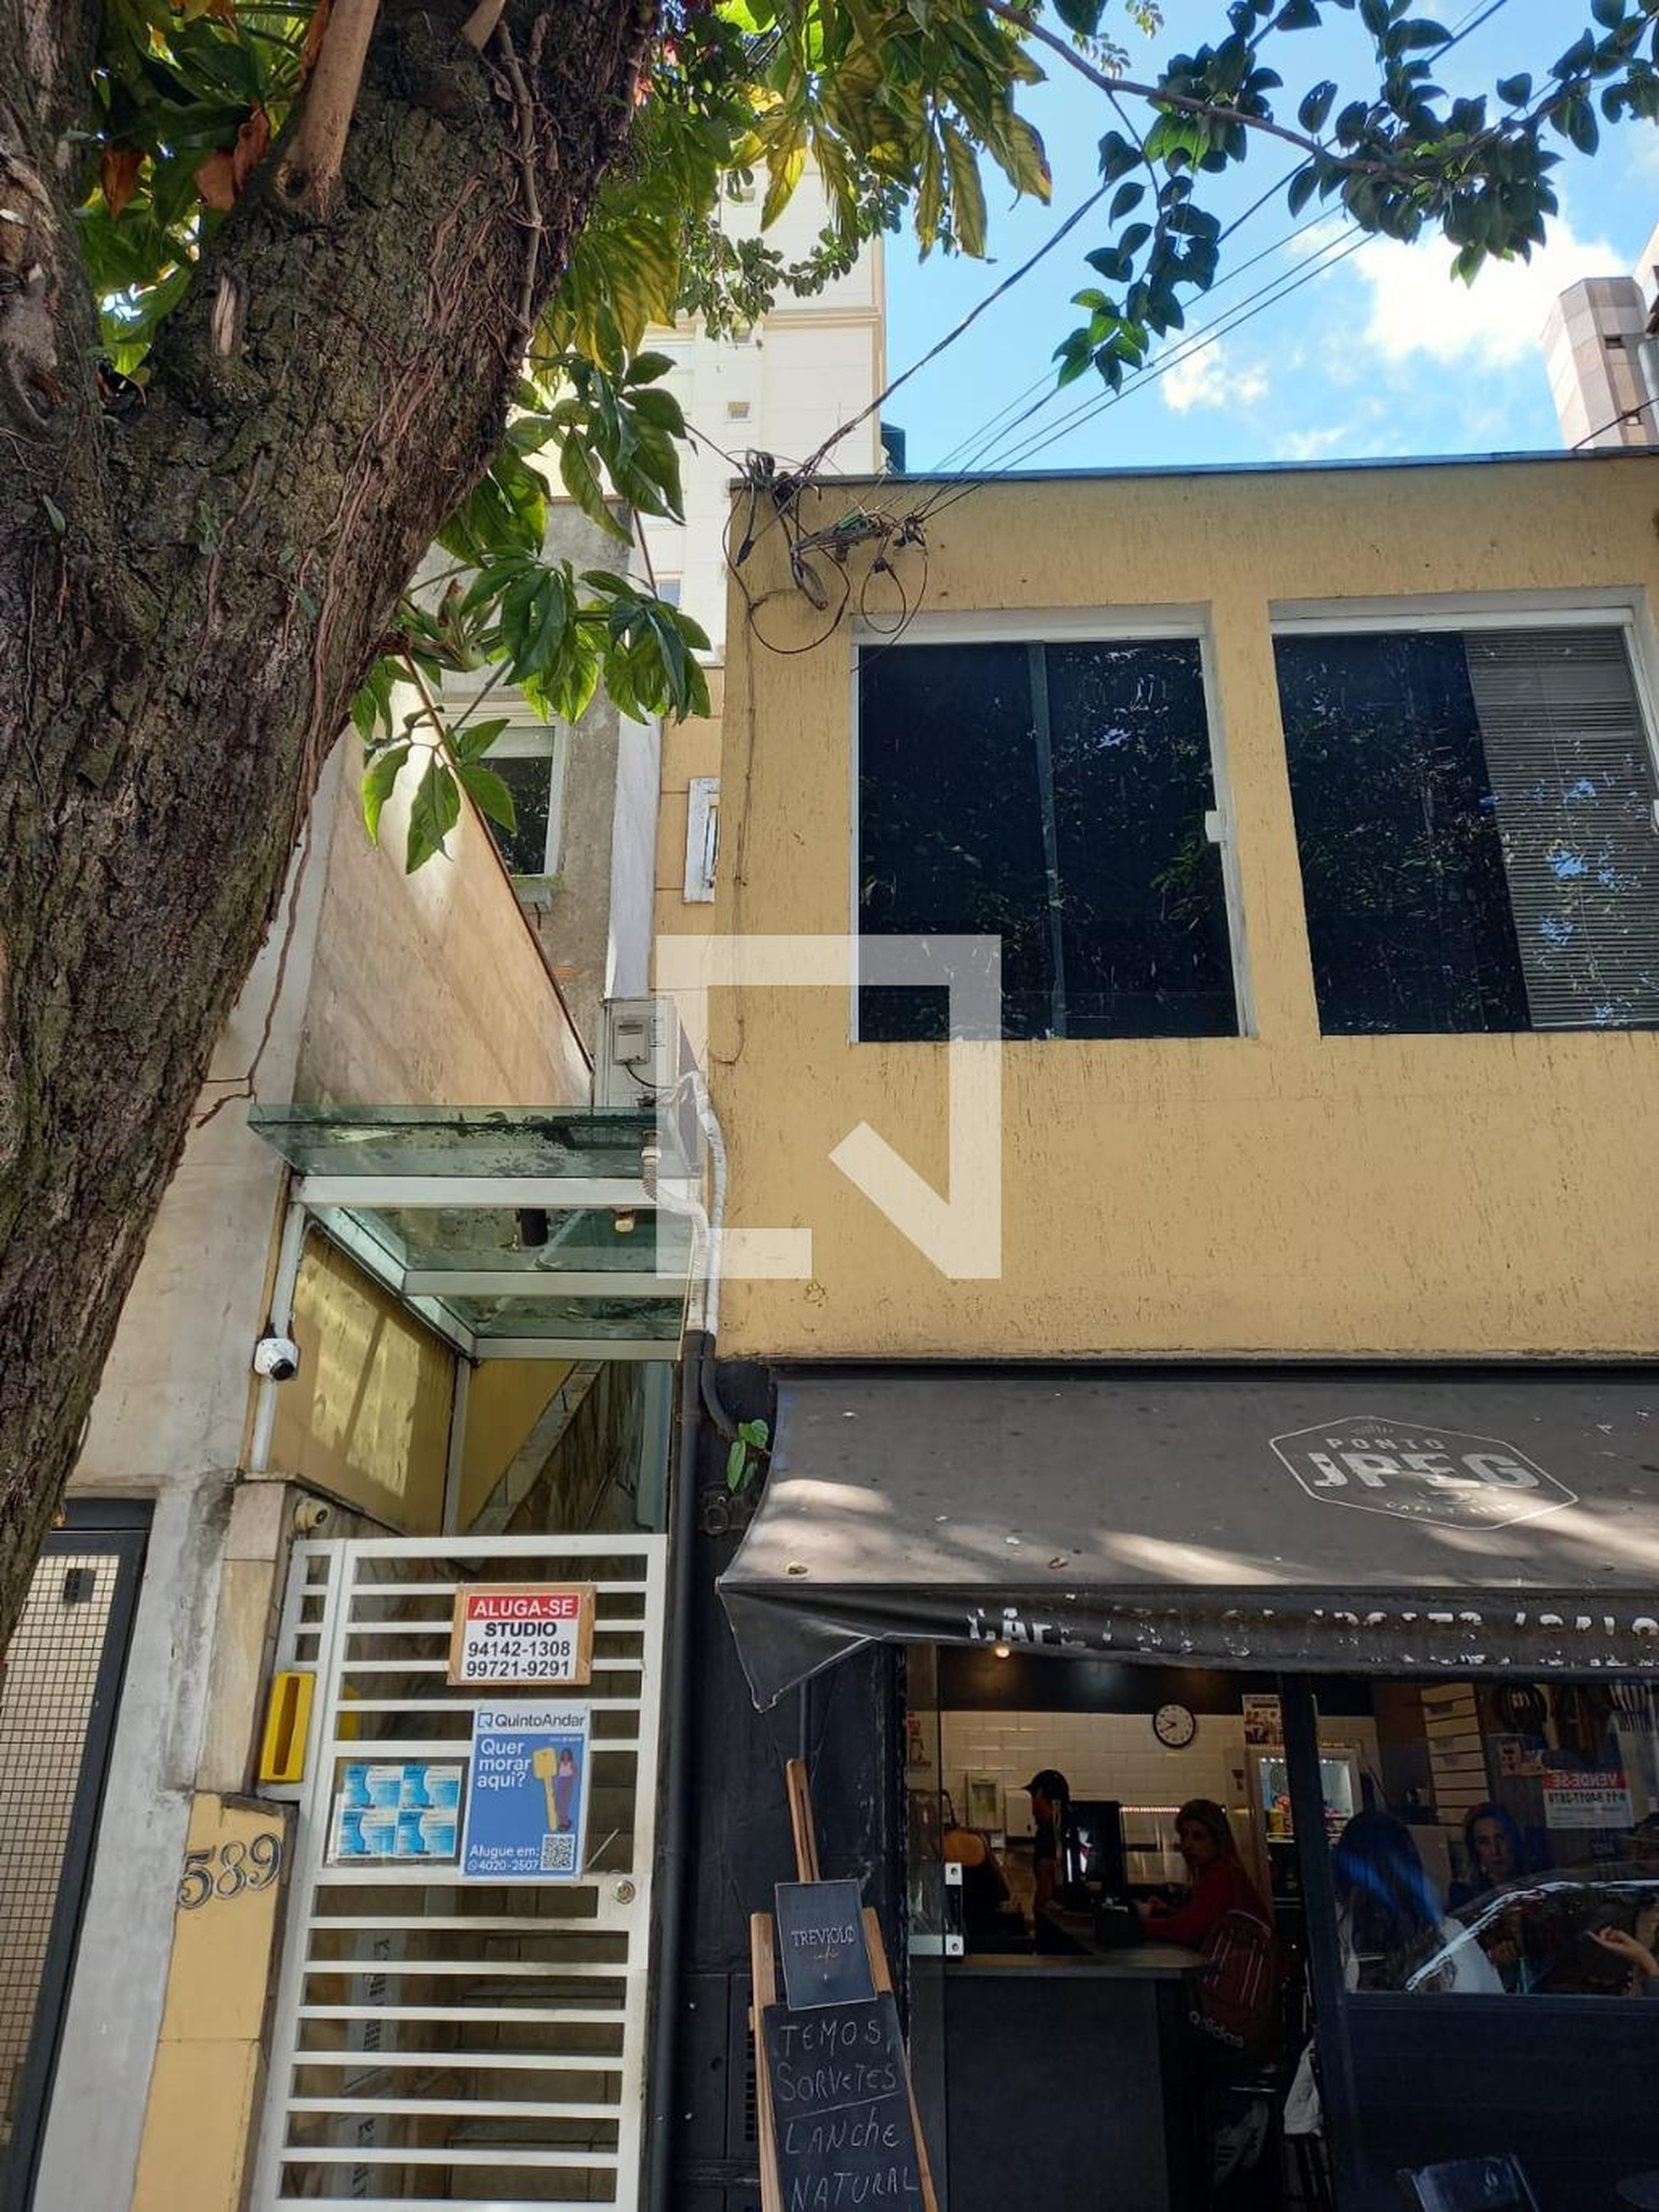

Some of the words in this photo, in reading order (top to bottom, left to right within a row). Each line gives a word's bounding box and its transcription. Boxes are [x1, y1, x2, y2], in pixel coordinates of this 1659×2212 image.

[1325, 1438, 1446, 1449] PONTO
[1308, 1452, 1539, 1489] JPEG
[474, 1599, 573, 1617] ALUGA-SE
[484, 1622, 557, 1637] STUDIO
[467, 1641, 571, 1657] 94142-1308
[466, 1660, 569, 1677] 99721-9291
[495, 1713, 585, 1728] QuintoAndar
[480, 1738, 524, 1756] Quer
[478, 1758, 531, 1771] morar
[477, 1772, 526, 1791] aqui?
[469, 1844, 514, 1859] Alugue
[516, 1847, 540, 1857] em:
[176, 1833, 282, 1910] 589
[780, 2020, 881, 2057] TEMOS
[791, 2166, 920, 2212] NATURAL
